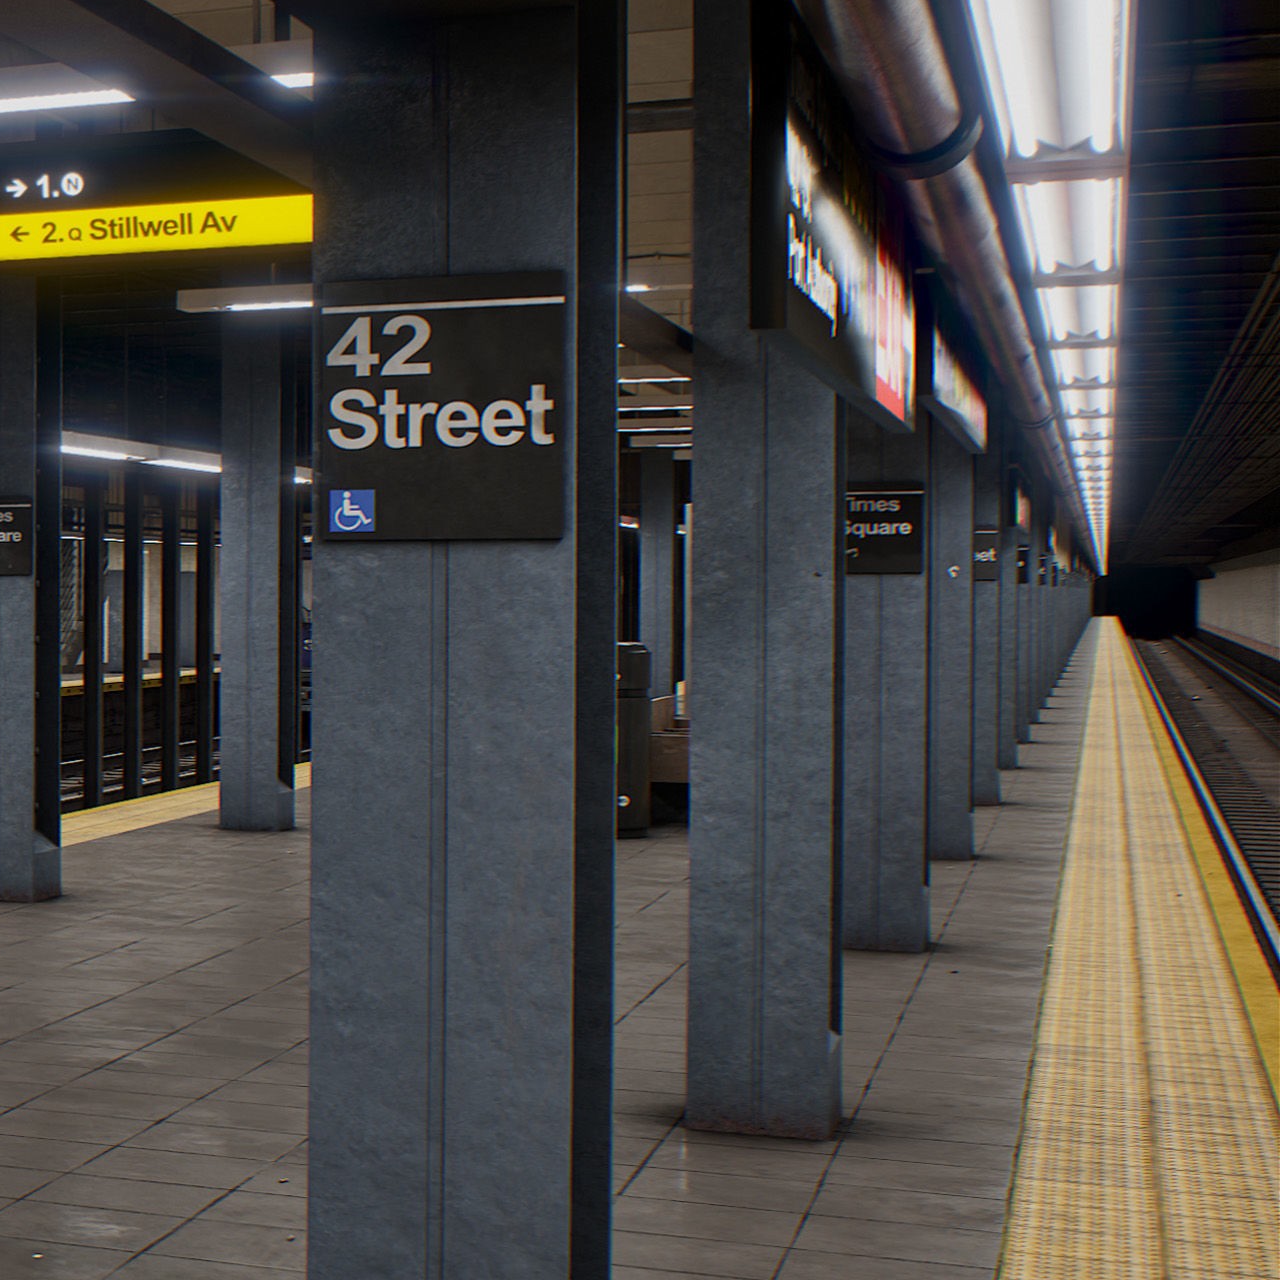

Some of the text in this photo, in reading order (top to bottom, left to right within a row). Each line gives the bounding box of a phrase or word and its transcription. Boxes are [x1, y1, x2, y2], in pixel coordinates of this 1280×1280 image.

[89, 212, 193, 241] Stillwell
[200, 211, 238, 234] Av
[326, 314, 432, 377] 42
[327, 384, 555, 450] Street
